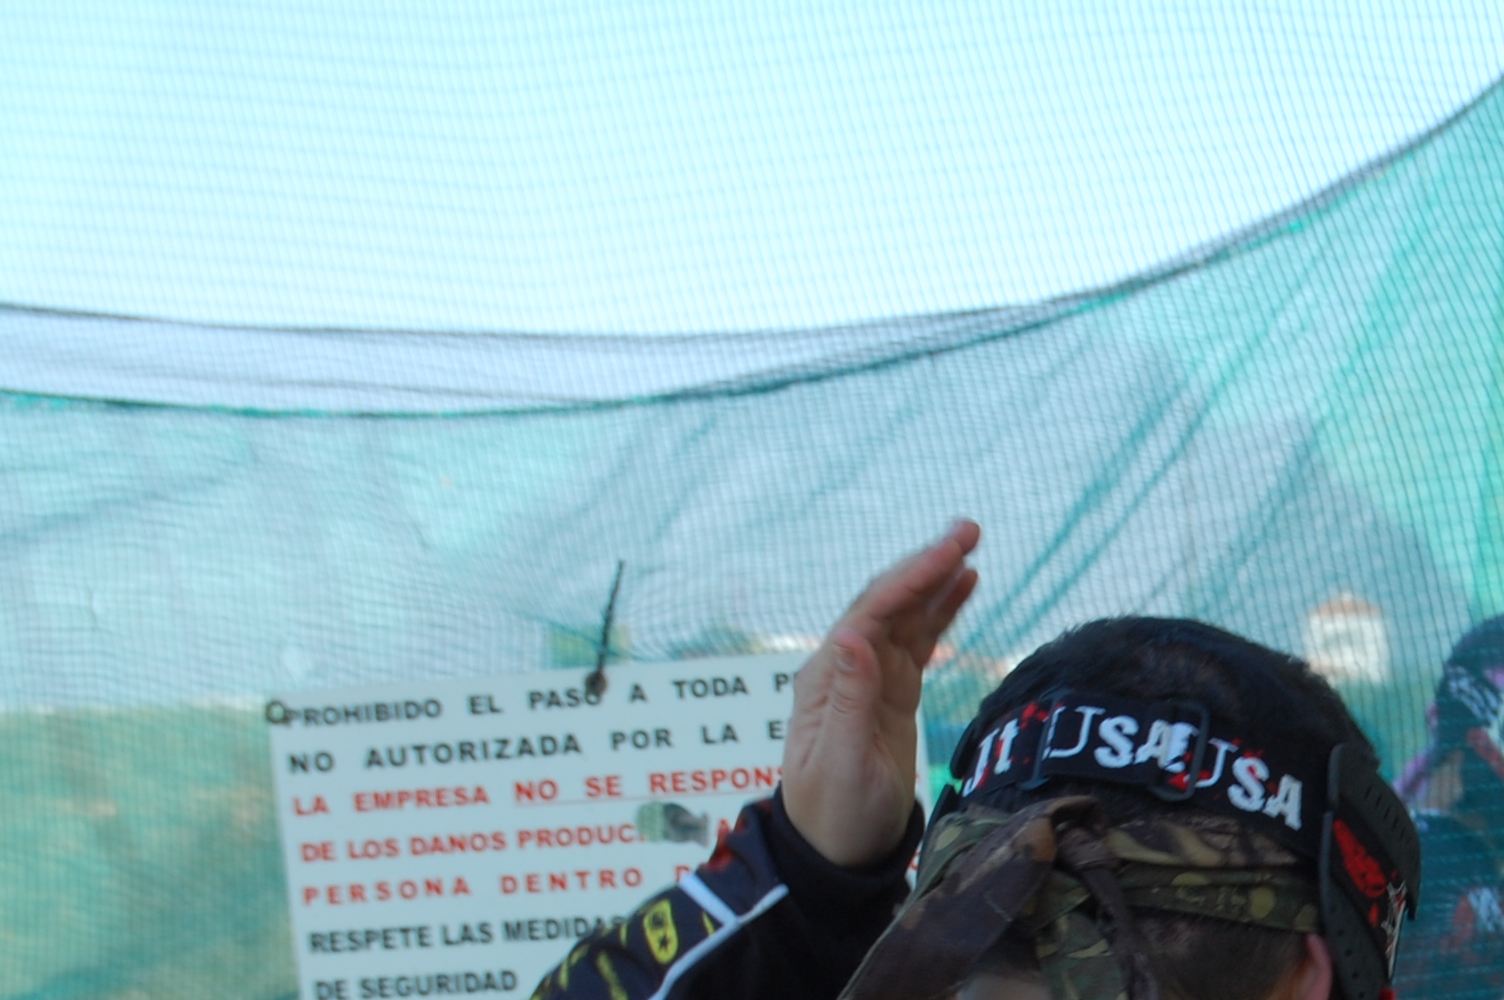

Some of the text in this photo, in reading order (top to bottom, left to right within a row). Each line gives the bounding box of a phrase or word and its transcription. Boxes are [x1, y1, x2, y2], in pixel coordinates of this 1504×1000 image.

[284, 697, 442, 728] PROHIBIDO
[466, 694, 502, 716] EL
[628, 682, 647, 703] A
[671, 675, 748, 699] TODA
[286, 723, 738, 774] NO AUTORIZADA POR LA
[295, 767, 784, 816] LA EMPRESA NO SE RESPON
[301, 842, 332, 862] DE
[348, 838, 399, 860] LOS
[518, 822, 644, 848] PRODUC
[304, 868, 642, 905] PERSONA DENTRO
[306, 924, 432, 954] RESPETE
[440, 921, 493, 947] LAS
[357, 969, 518, 1000] SEGURIDAD
